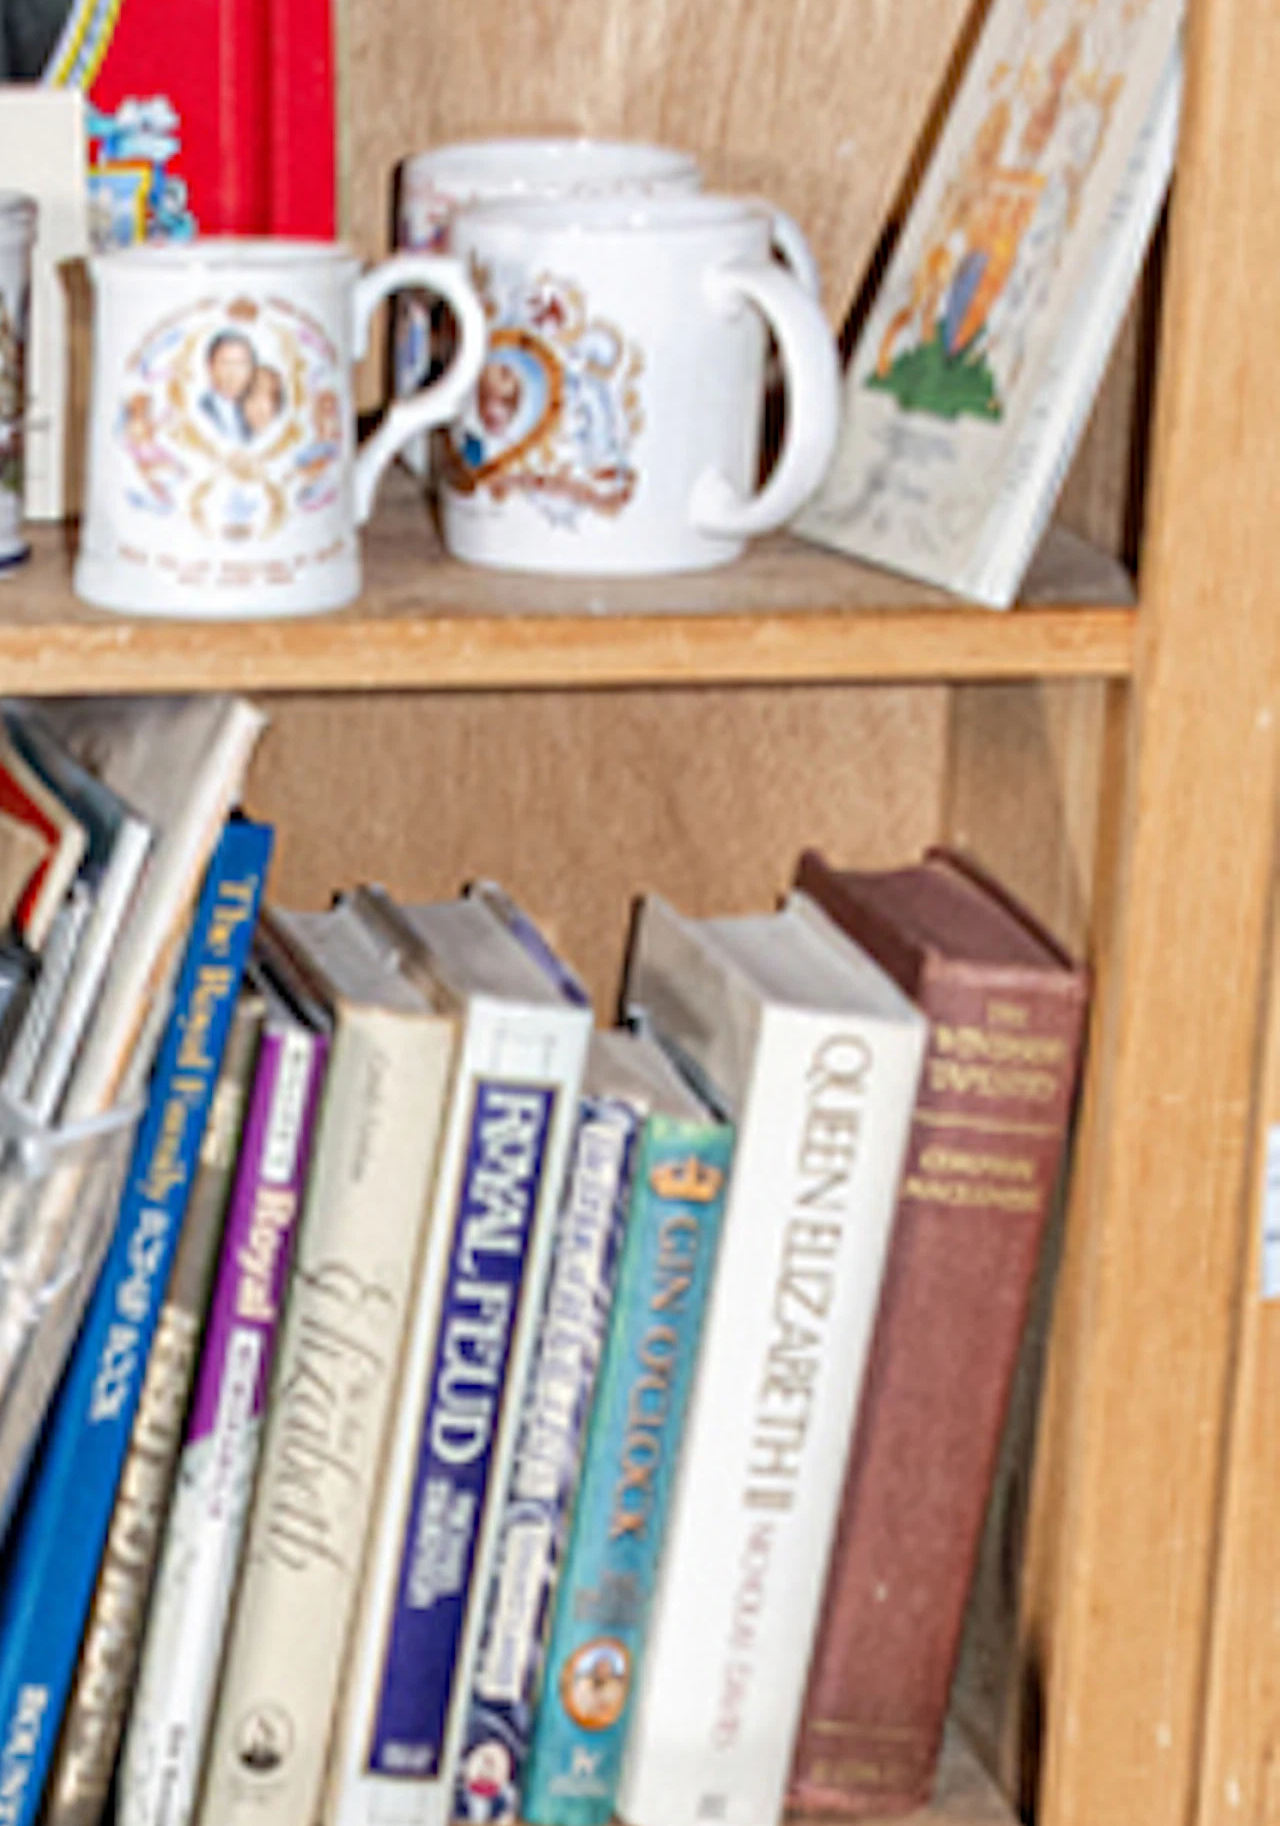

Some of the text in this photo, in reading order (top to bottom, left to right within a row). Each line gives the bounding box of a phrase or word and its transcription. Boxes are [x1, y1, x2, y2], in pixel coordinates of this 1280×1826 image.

[200, 875, 255, 956] The
[166, 965, 237, 1066] Royal
[133, 1077, 205, 1202] Family
[797, 1035, 873, 1209] QUEEN
[110, 1208, 170, 1320] POP-UP
[226, 1186, 293, 1319] Royal
[428, 1090, 544, 1465] ROYAL FEUD
[86, 1324, 143, 1422] BOOK
[254, 1255, 398, 1576] Elizabeth
[608, 1214, 699, 1540] GIN O'CLOCK
[747, 1222, 842, 1477] ELIZABETH
